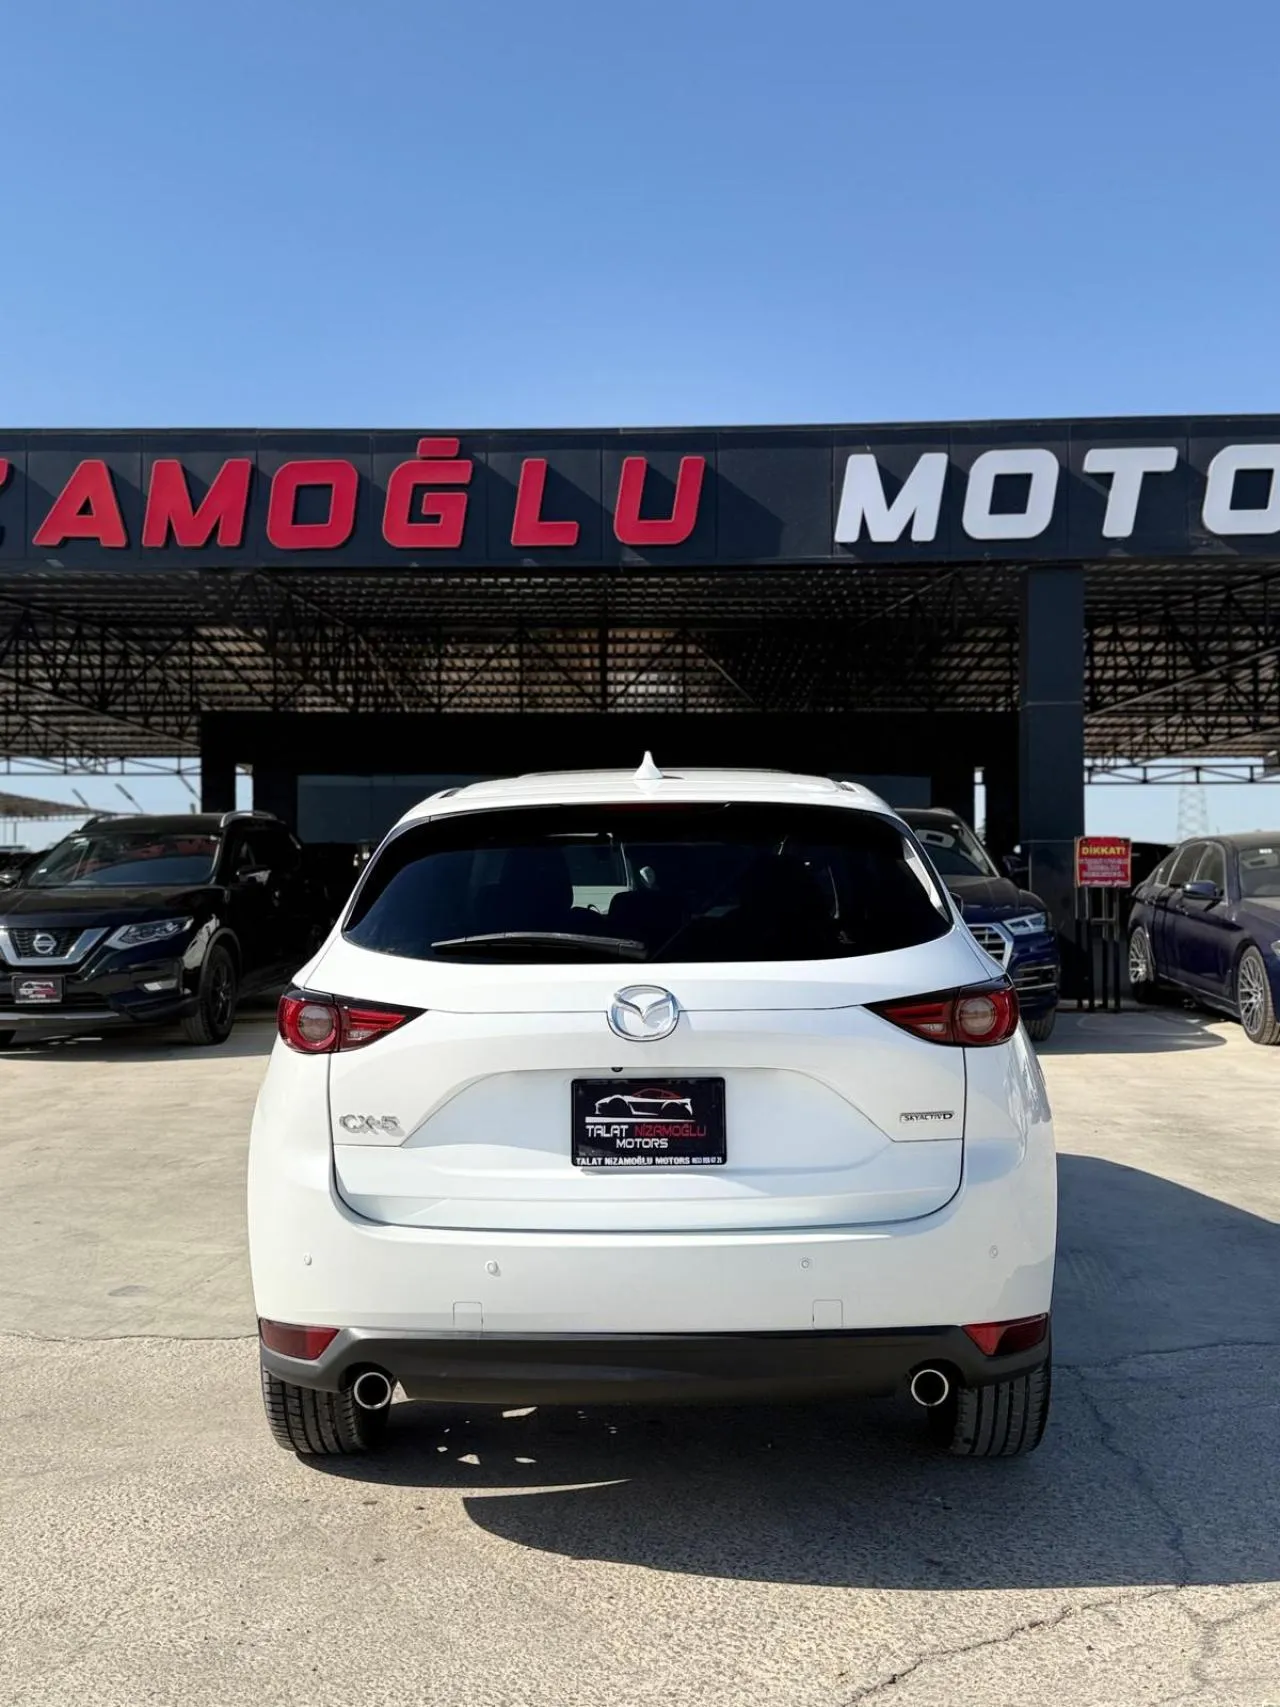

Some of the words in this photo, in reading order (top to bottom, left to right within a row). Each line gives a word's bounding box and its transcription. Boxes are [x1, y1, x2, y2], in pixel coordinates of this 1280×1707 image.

[0, 437, 706, 549] AMOĞLU
[833, 443, 1280, 543] MOTO
[339, 1114, 402, 1134] CX-5
[585, 1125, 629, 1138] TALAT
[616, 1138, 668, 1149] MOTORS
[576, 1157, 603, 1166] TALAT
[655, 1156, 690, 1165] MOTORS
